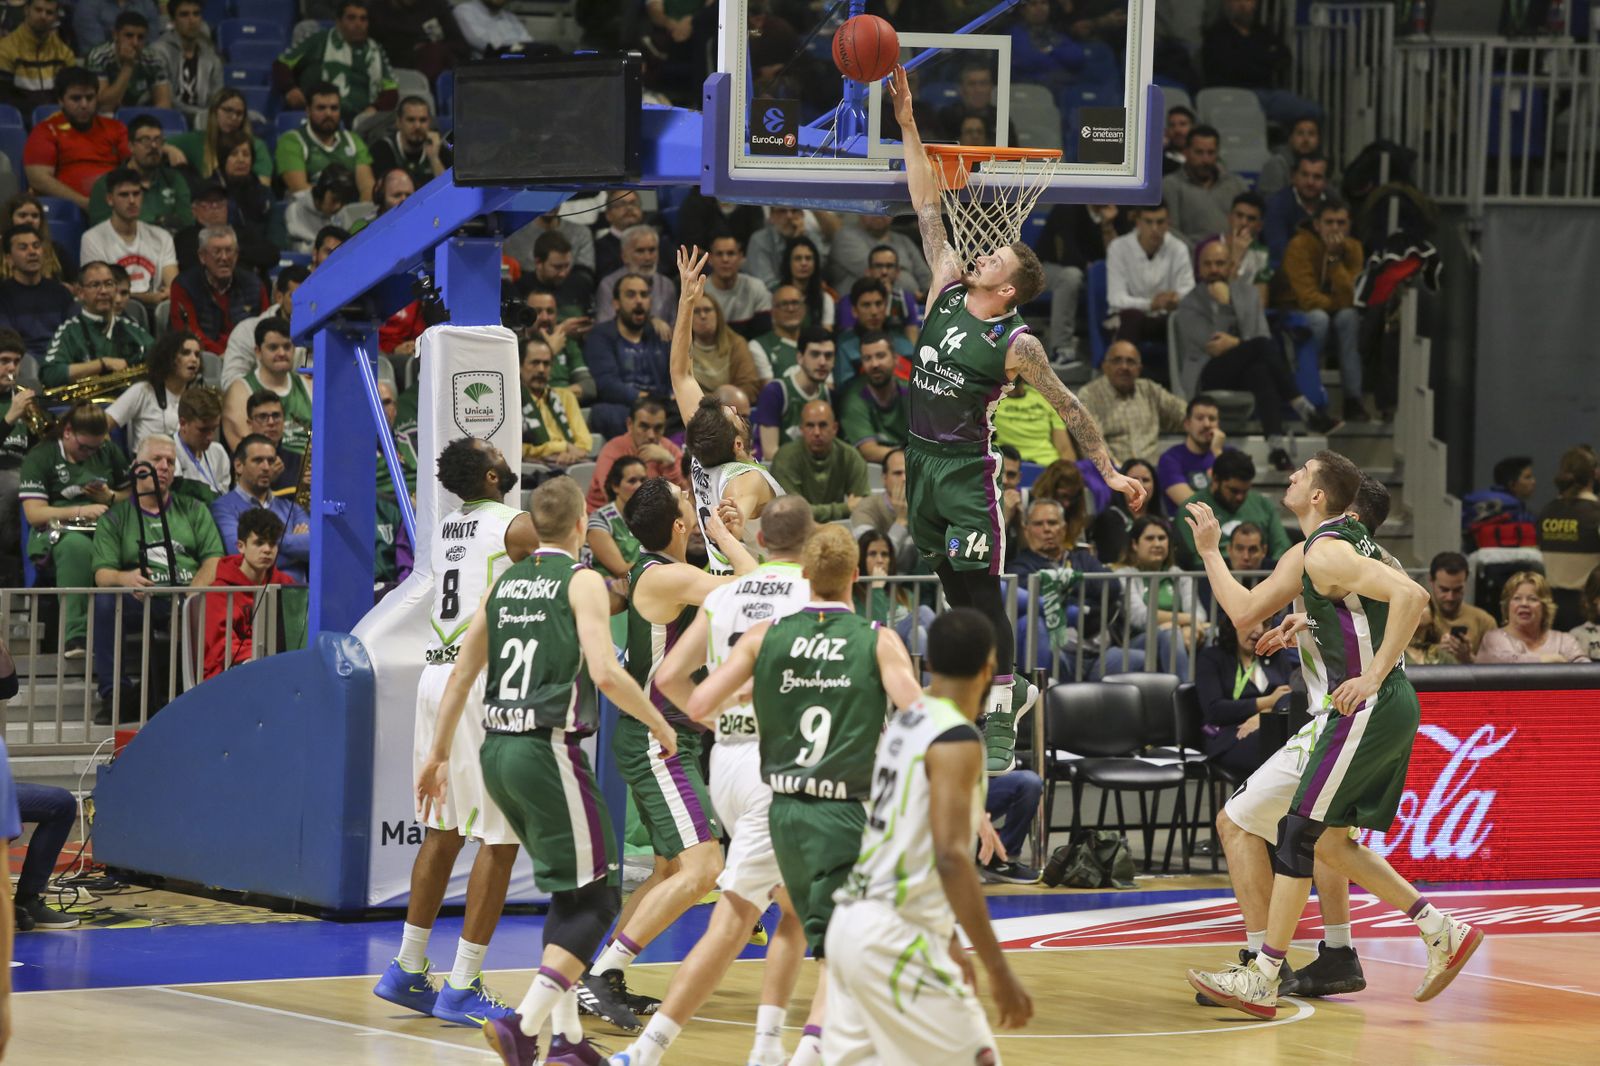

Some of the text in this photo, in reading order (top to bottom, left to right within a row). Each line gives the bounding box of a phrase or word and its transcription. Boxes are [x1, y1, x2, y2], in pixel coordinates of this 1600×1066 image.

[752, 135, 784, 146] EuroCup
[1092, 130, 1124, 138] oneteam
[940, 326, 968, 355] 14
[934, 363, 965, 385] Unicaja
[464, 406, 494, 416] Unicaja
[442, 519, 479, 539] WHITE
[964, 531, 990, 560] 14
[440, 568, 460, 620] 8
[790, 633, 848, 661] DÍAZ
[499, 638, 539, 700] 21
[794, 705, 833, 768] 9
[381, 819, 428, 846] Má
